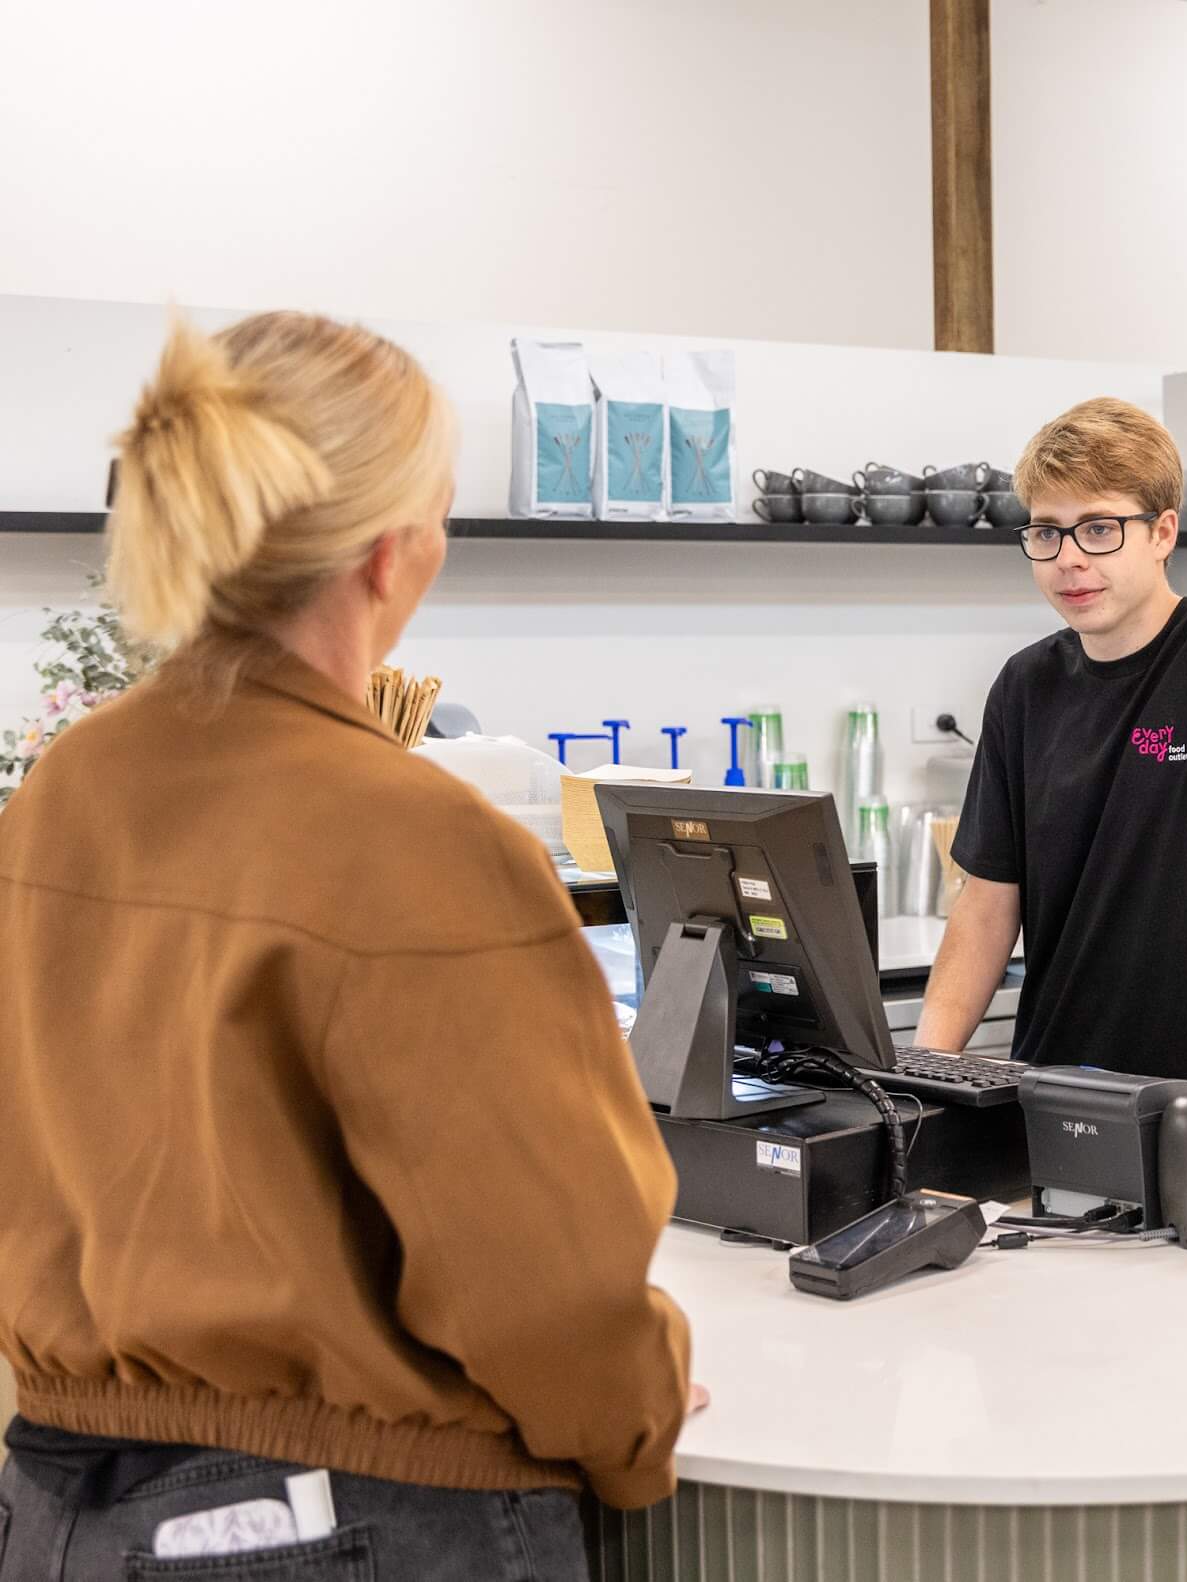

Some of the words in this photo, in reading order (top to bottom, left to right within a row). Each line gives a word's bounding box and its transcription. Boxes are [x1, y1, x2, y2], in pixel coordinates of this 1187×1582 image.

[1138, 740, 1168, 762] day
[1168, 743, 1186, 753] food
[673, 821, 707, 838] SENOR
[1062, 1120, 1099, 1138] SENOR
[759, 1145, 799, 1164] SENOR
